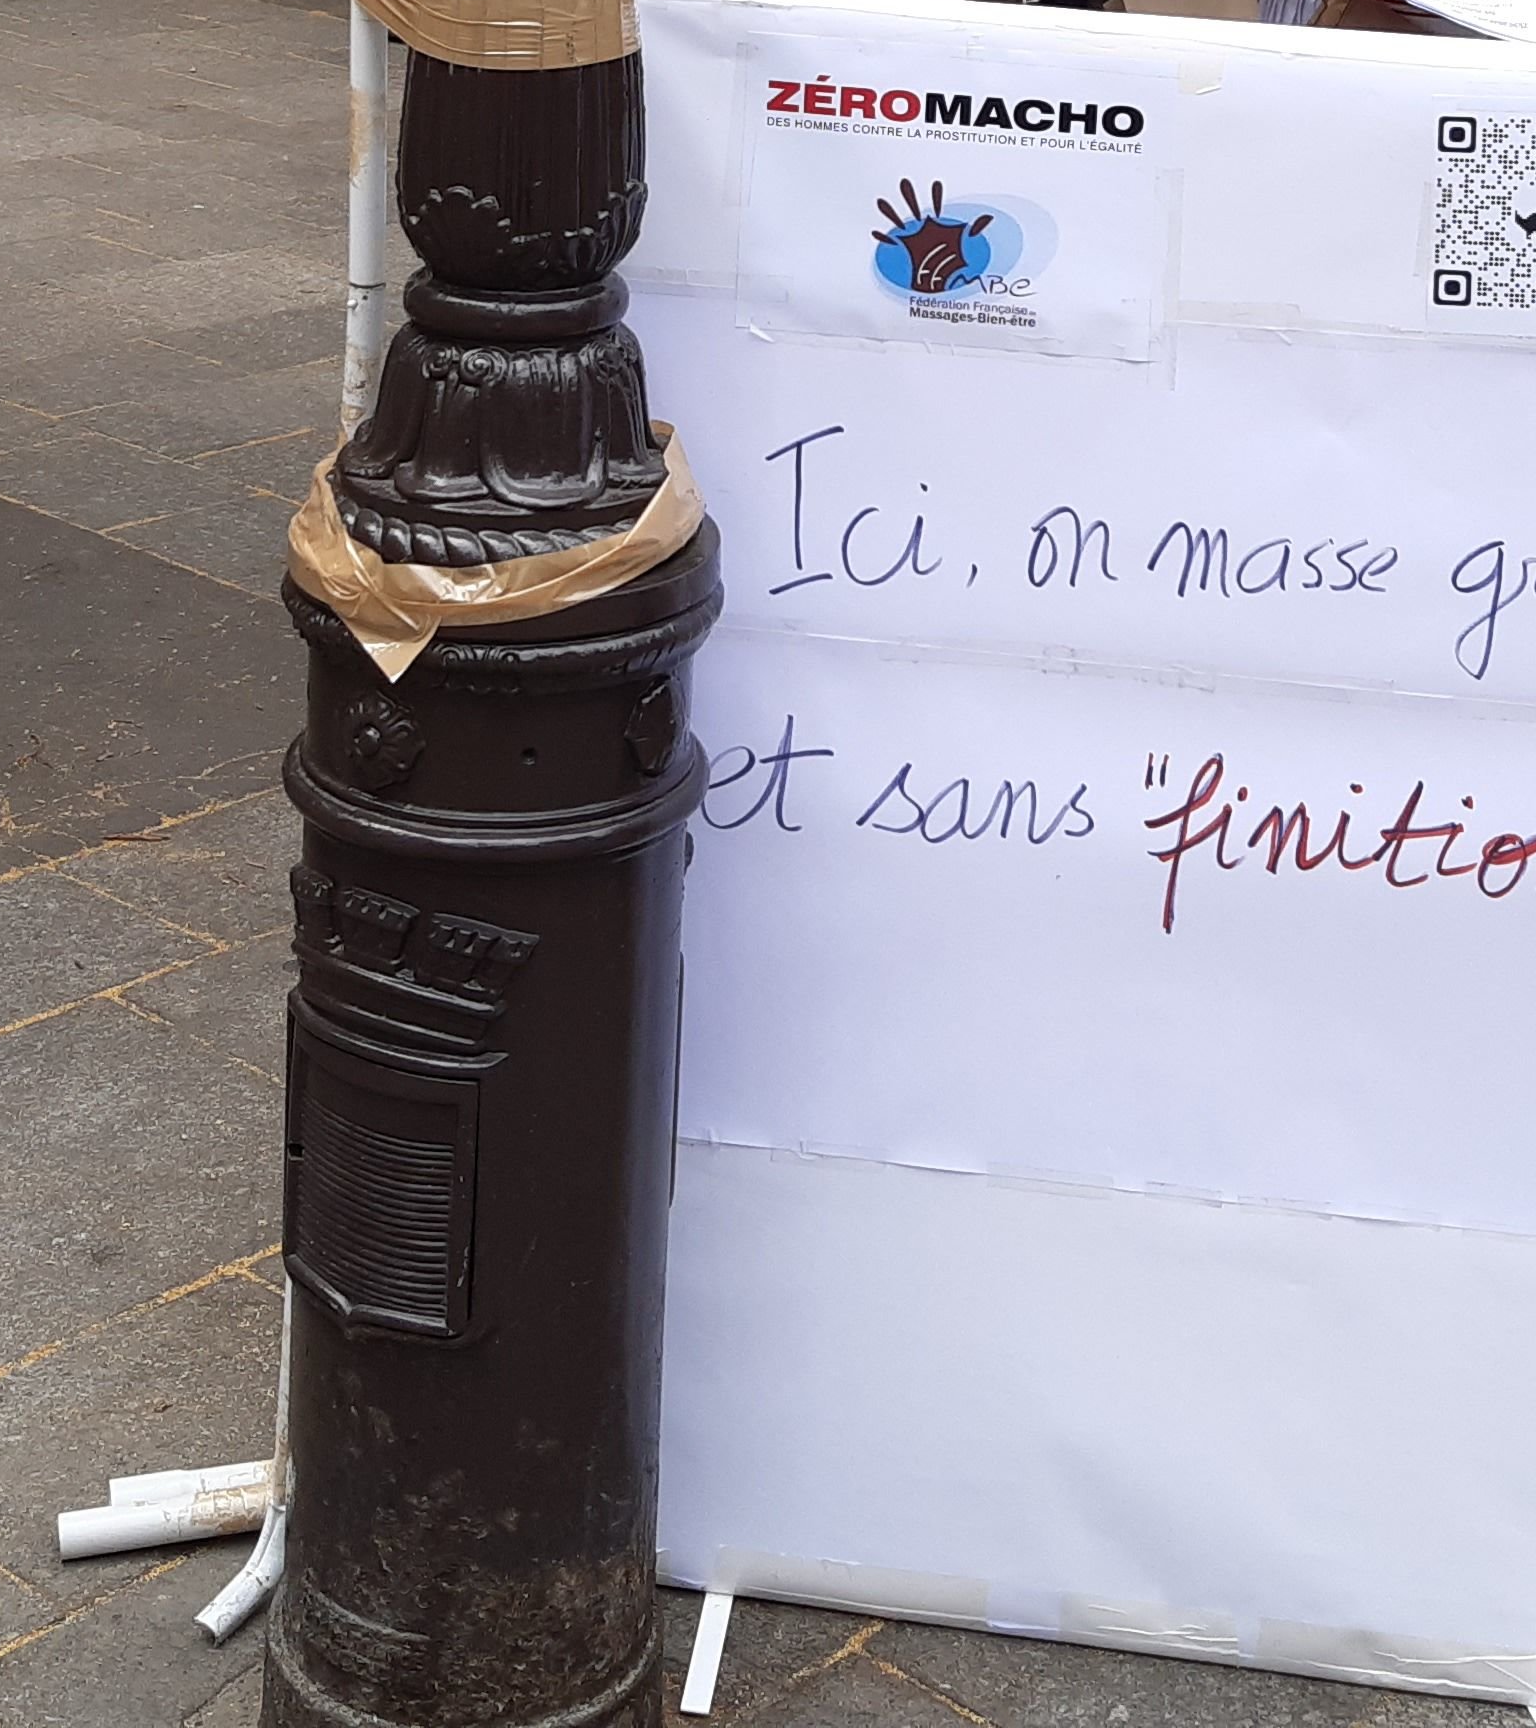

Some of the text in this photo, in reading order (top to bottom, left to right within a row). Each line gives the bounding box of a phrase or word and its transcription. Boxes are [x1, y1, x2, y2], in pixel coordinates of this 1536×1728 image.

[766, 75, 1145, 138] ZÉROMACHO
[766, 116, 1143, 154] DES HOMMES CONTRE LA PROSTITUTION ET POUR L'ÉGALITÉ
[909, 296, 970, 311] Fédération
[973, 301, 1028, 315] Française
[764, 425, 978, 597] Ici,
[1026, 505, 1117, 589] on
[1146, 519, 1400, 598] masse
[700, 714, 835, 833] et
[854, 760, 1097, 846] sans
